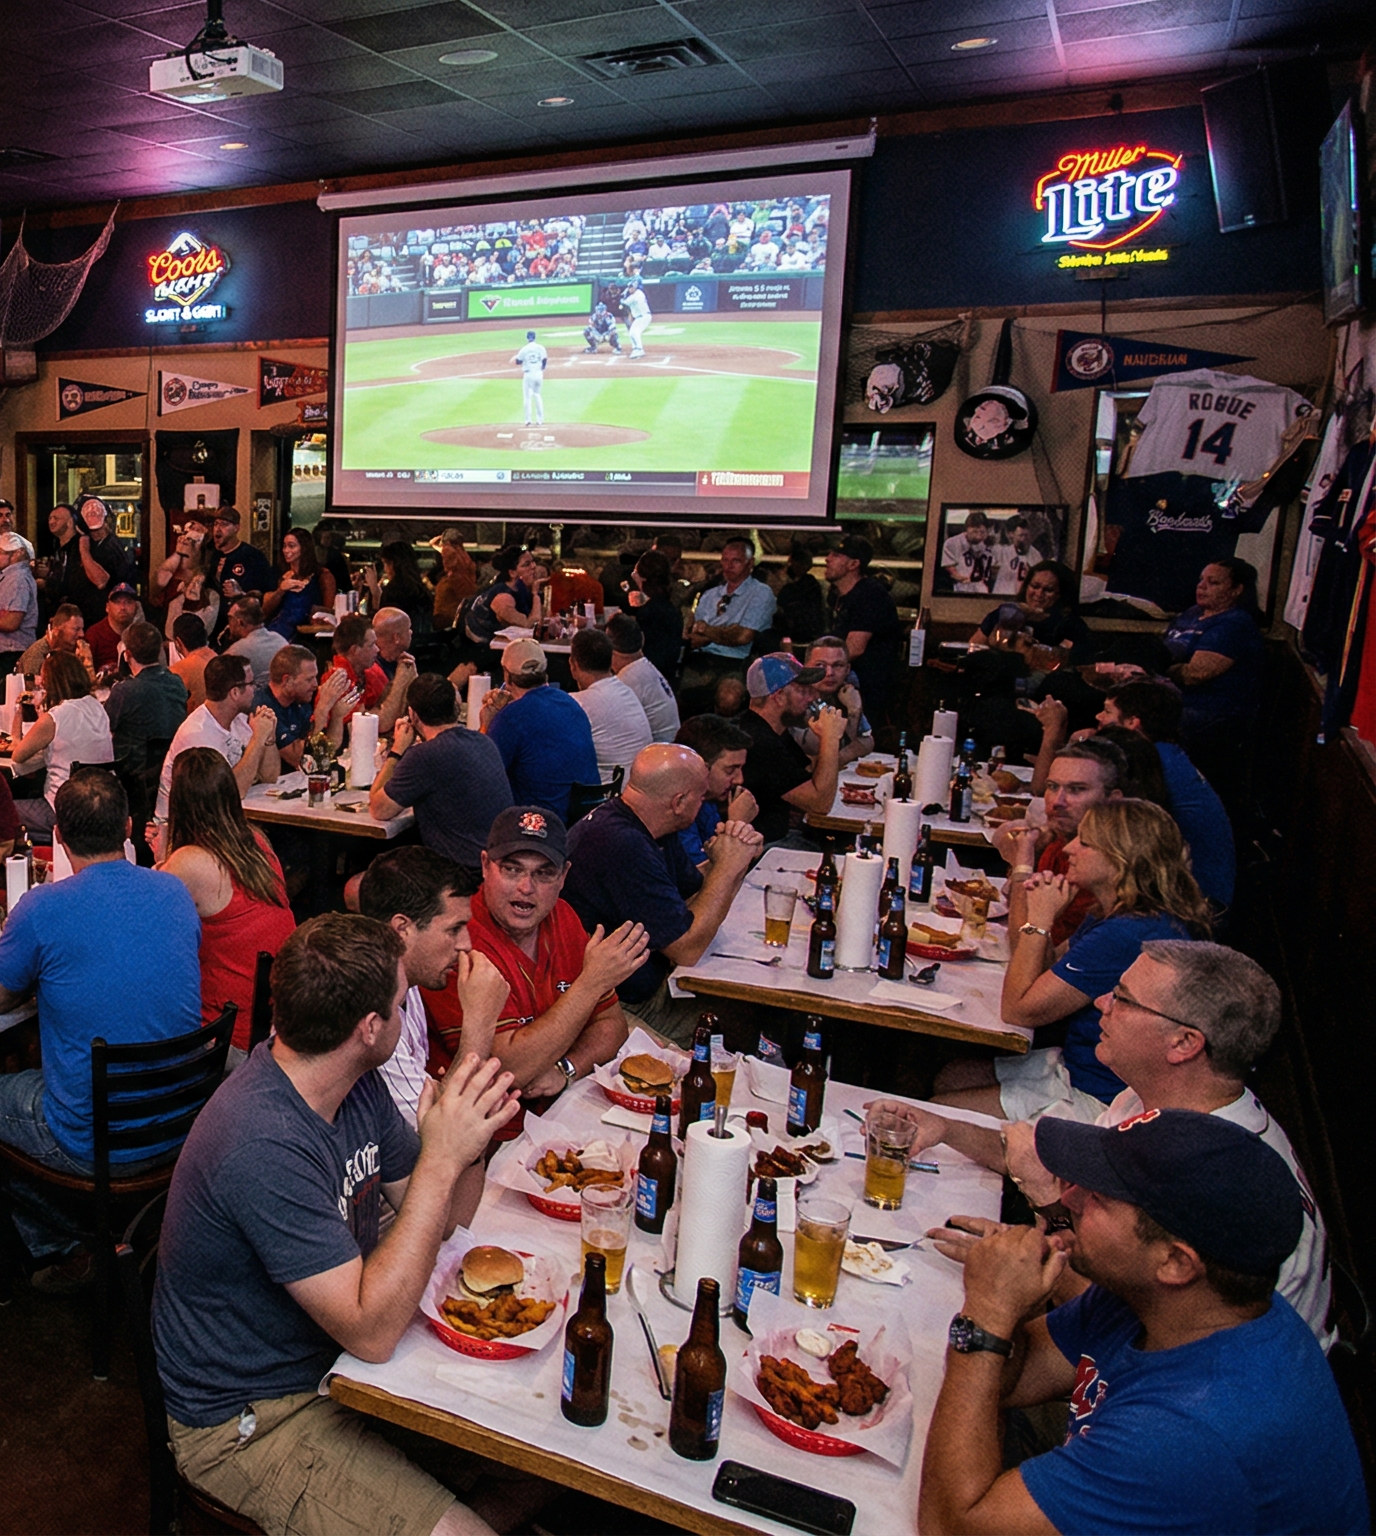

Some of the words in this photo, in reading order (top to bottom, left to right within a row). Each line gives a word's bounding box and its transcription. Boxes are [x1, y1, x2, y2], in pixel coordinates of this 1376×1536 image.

[1058, 146, 1146, 182] Miller
[1042, 166, 1178, 243] Lite
[148, 247, 222, 283] Coors
[1188, 393, 1257, 420] ROGUE
[1181, 418, 1238, 466] 14
